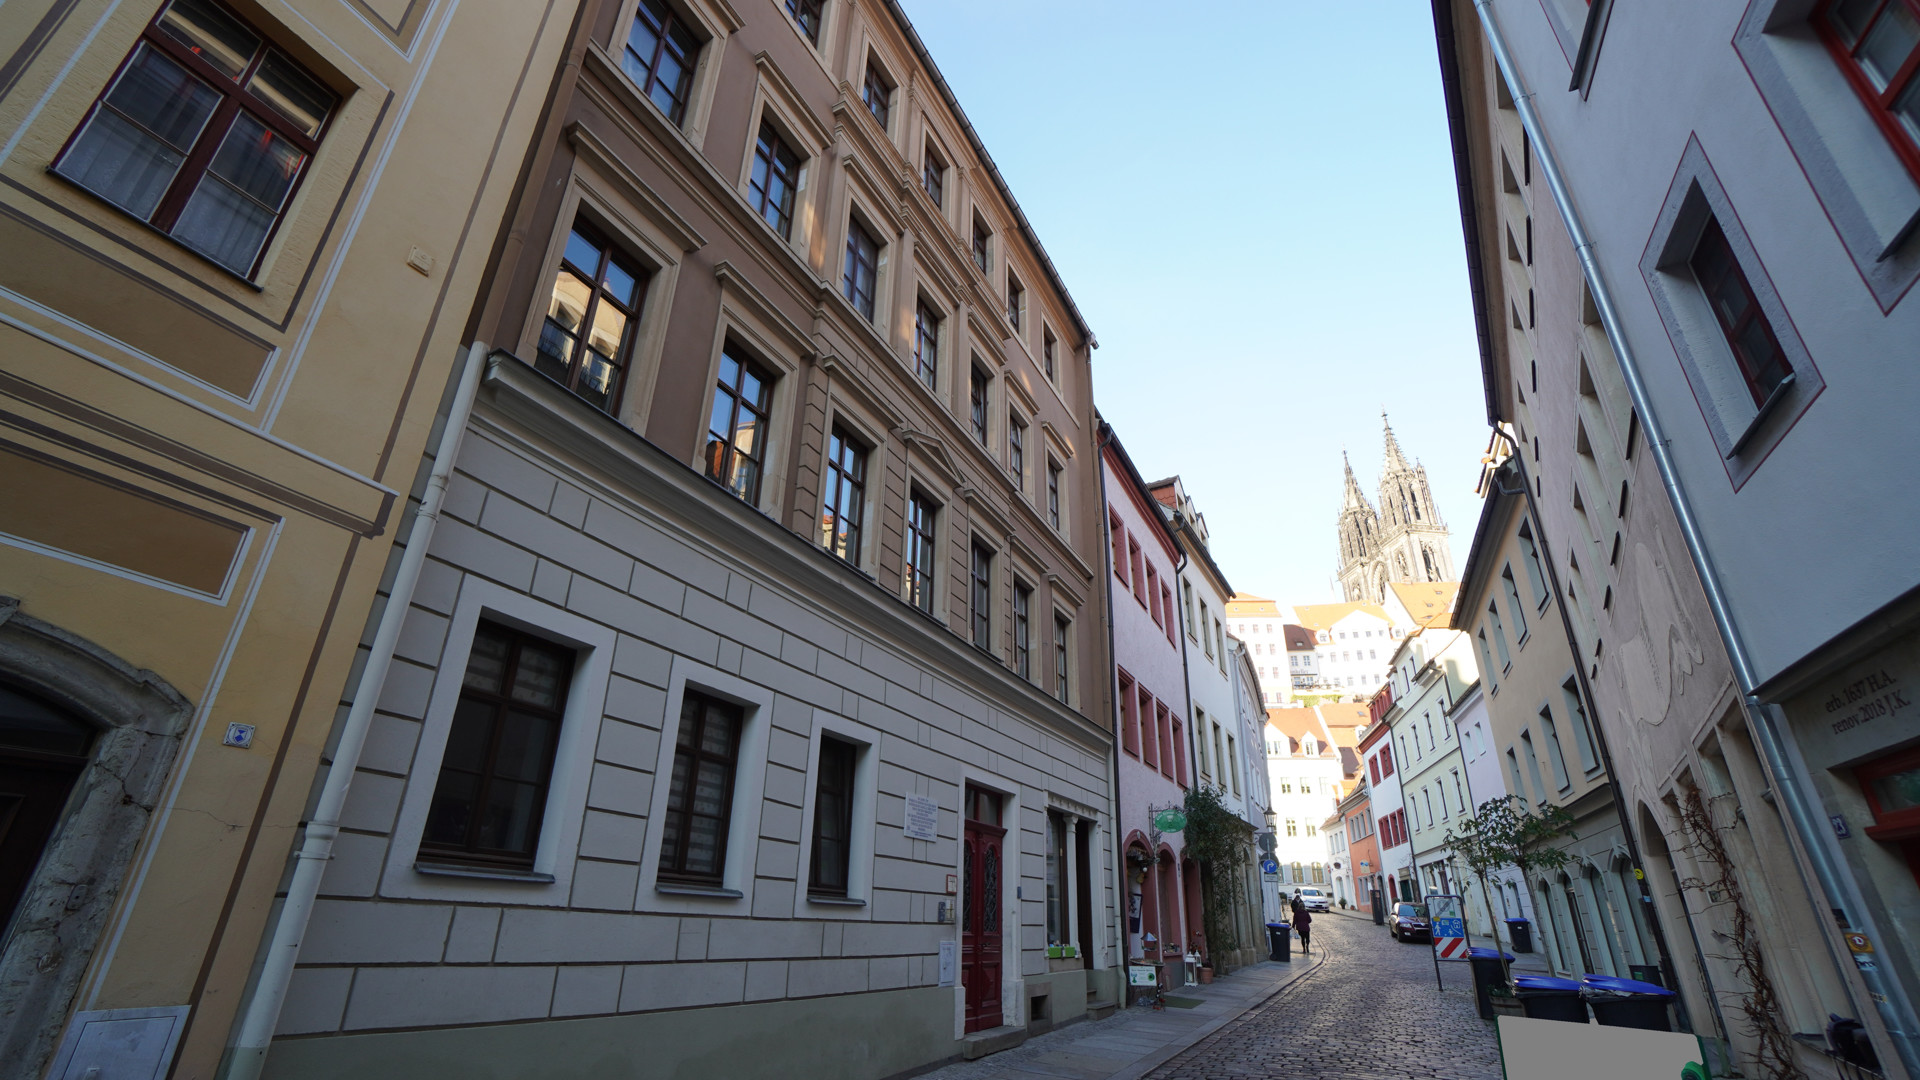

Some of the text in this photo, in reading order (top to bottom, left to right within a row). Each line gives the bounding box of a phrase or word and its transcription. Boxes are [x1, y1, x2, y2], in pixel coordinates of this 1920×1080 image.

[1825, 669, 1897, 713] erb. 1637 H.A.
[1883, 689, 1912, 717] J.K.
